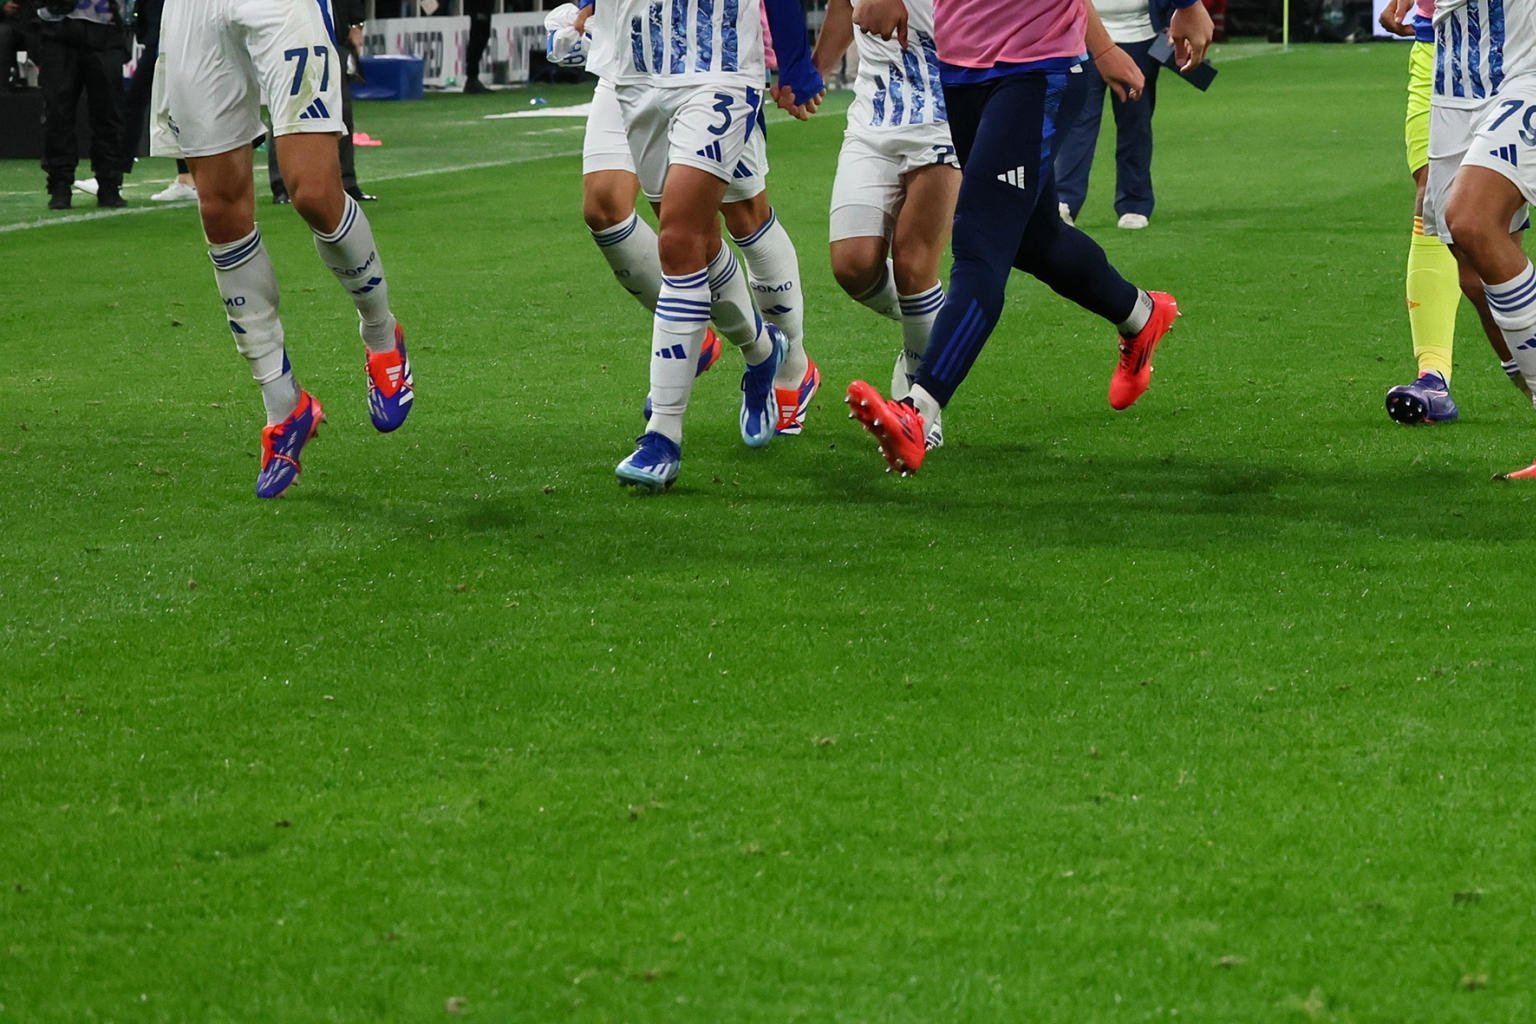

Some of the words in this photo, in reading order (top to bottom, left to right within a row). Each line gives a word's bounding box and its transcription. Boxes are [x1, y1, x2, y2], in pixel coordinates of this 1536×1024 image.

[284, 45, 330, 96] 77
[707, 92, 734, 136] 3
[223, 296, 246, 308] MO
